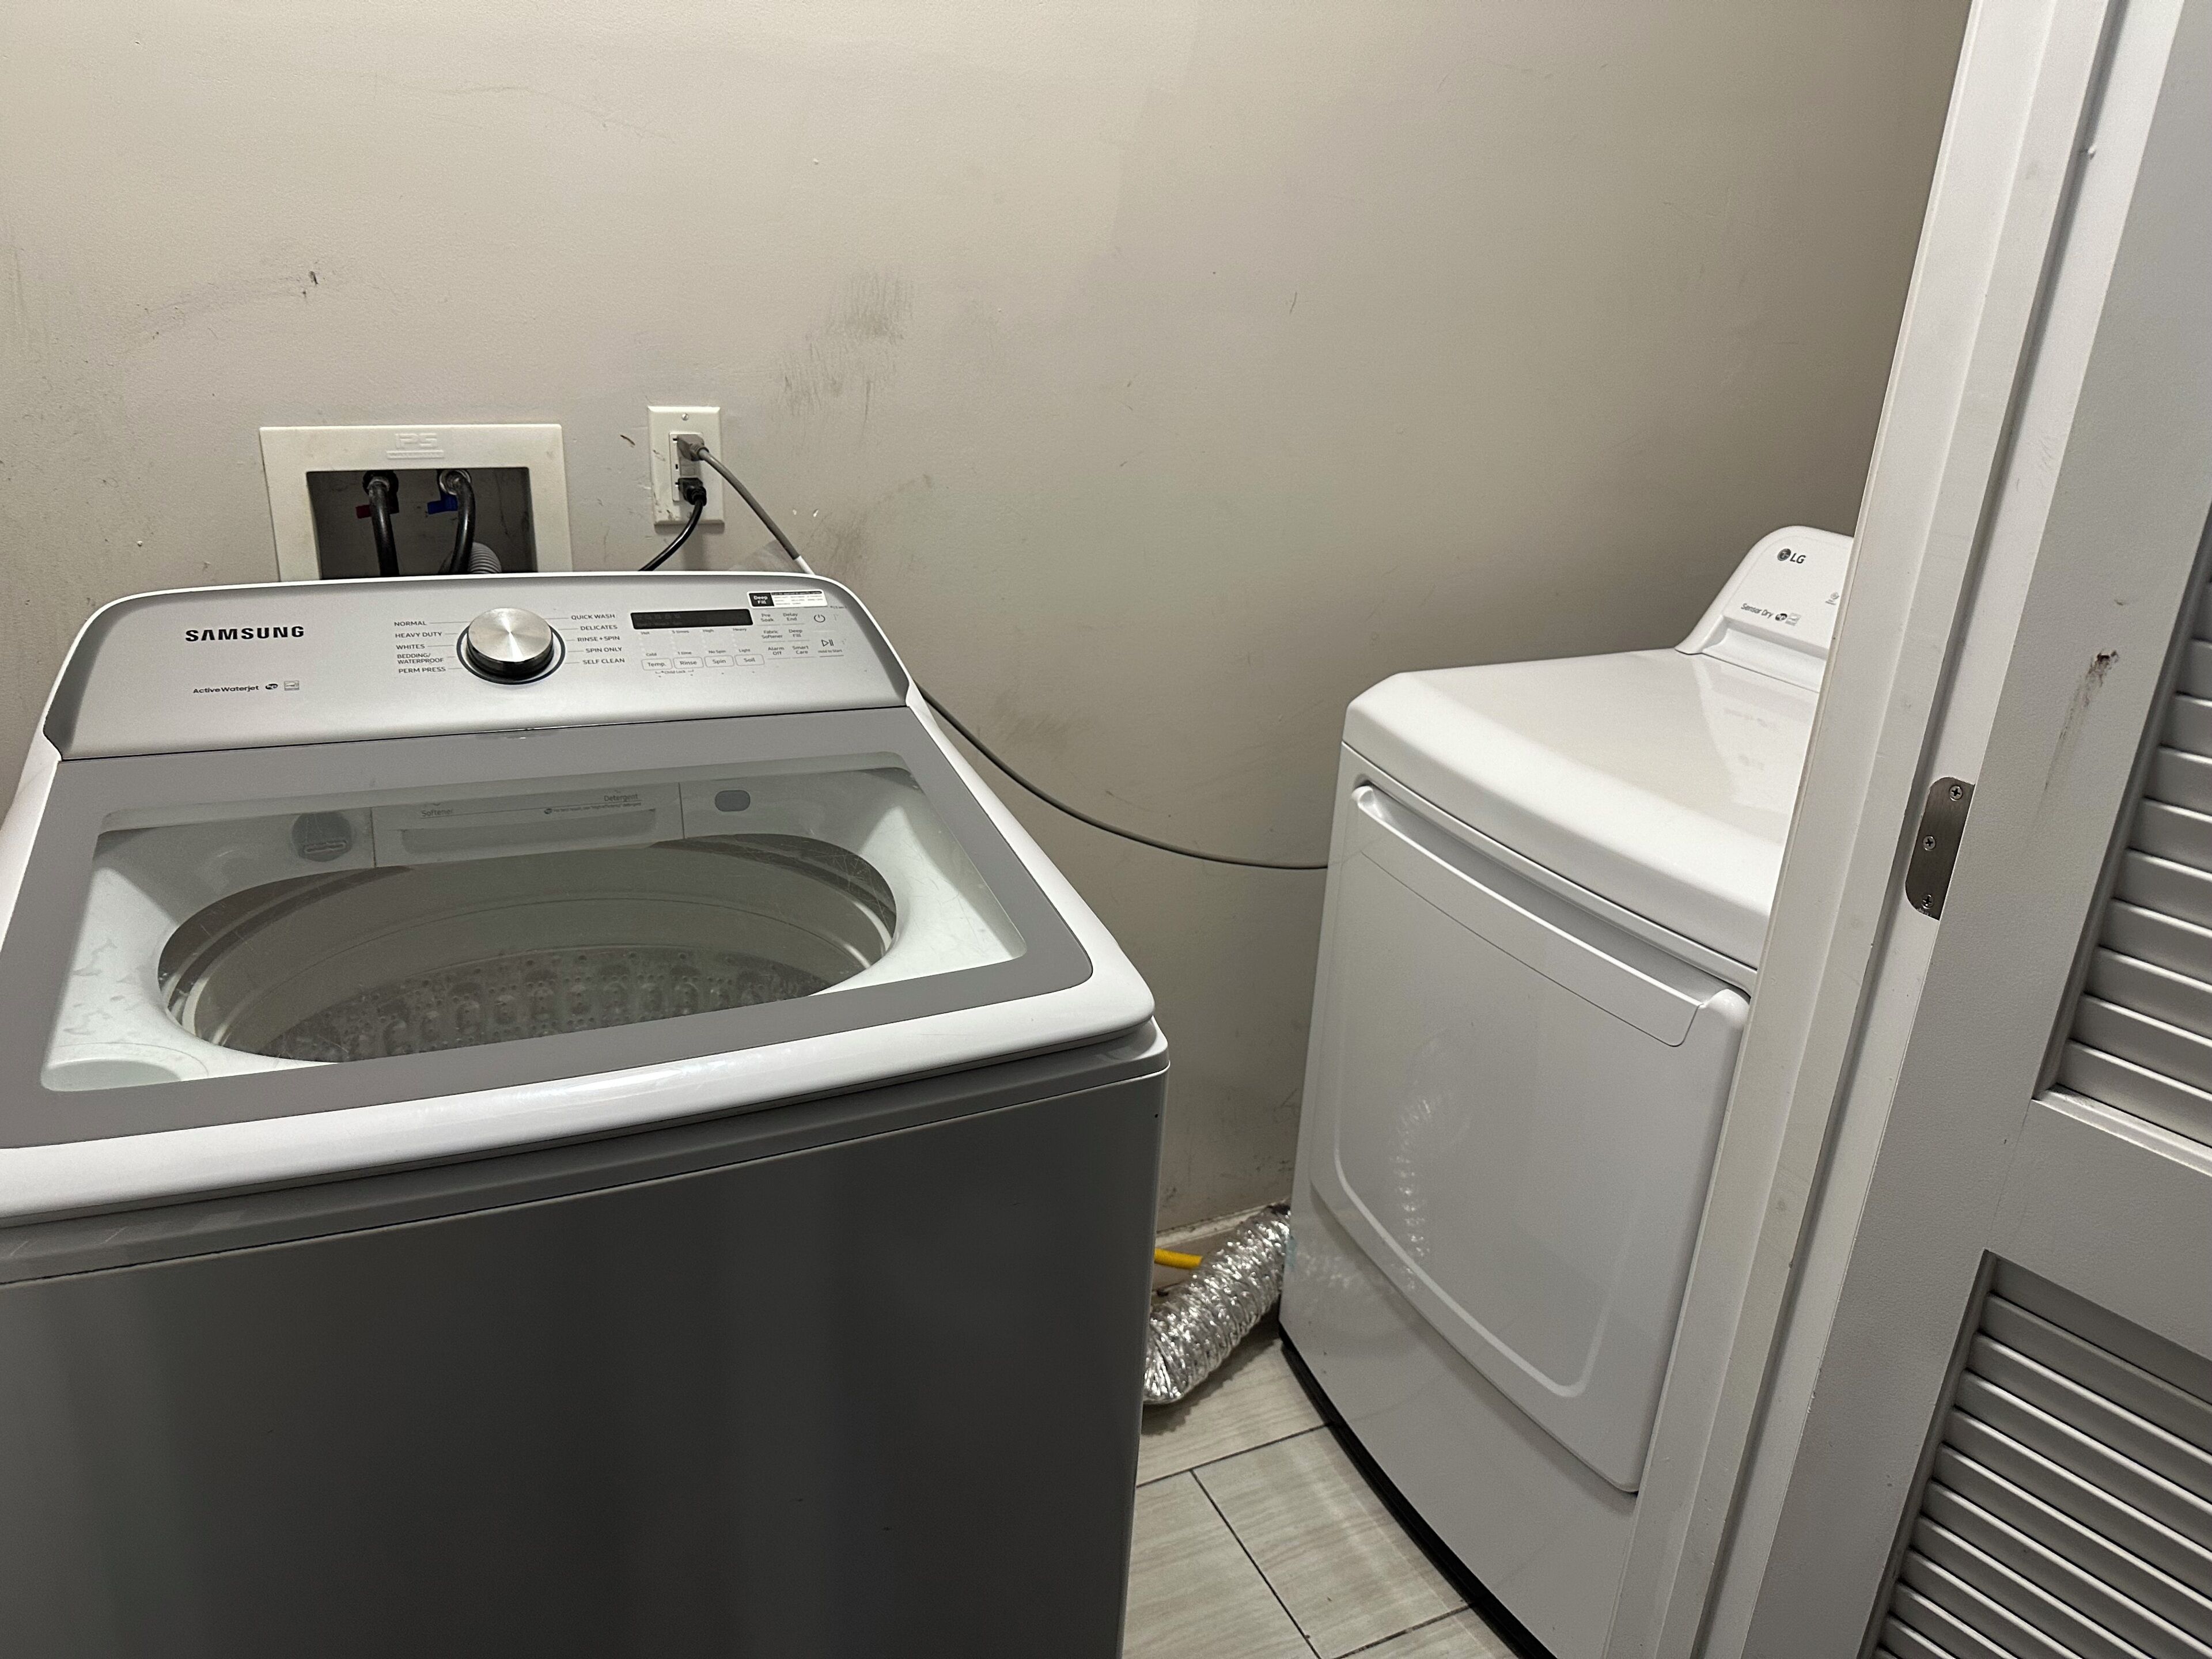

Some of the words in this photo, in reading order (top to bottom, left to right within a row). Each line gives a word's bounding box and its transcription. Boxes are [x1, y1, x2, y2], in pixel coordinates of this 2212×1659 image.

[1790, 553, 1806, 564] LG
[1741, 603, 1762, 614] Sensor
[1761, 609, 1774, 618] Dry
[185, 626, 304, 642] SAMSUNG
[604, 794, 638, 802] Detergent
